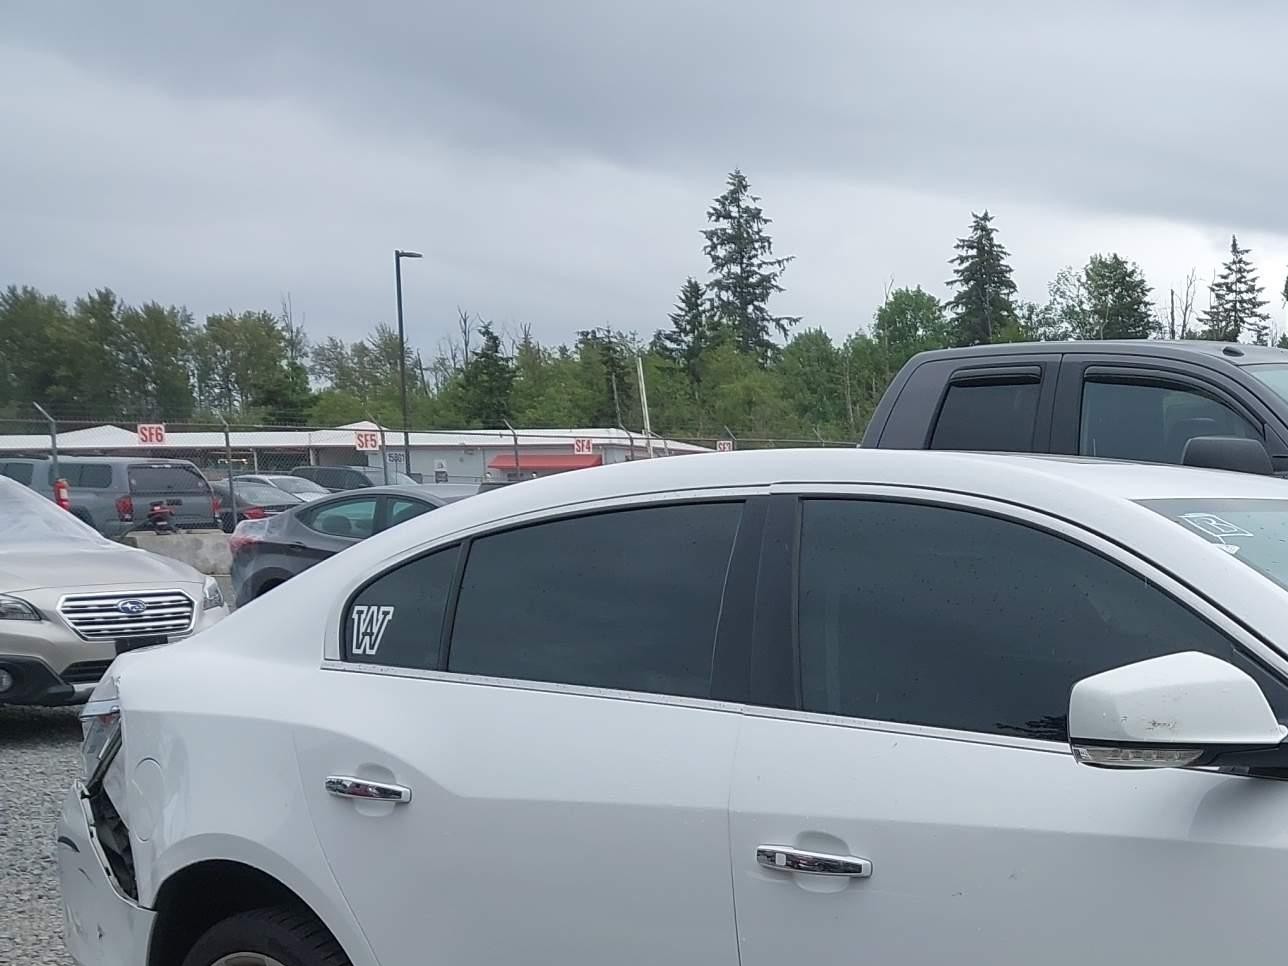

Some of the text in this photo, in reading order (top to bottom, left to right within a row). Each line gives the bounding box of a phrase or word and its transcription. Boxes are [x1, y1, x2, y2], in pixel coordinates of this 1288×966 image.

[140, 426, 164, 443] SF6
[356, 433, 377, 449] SF5
[575, 439, 591, 453] SF4
